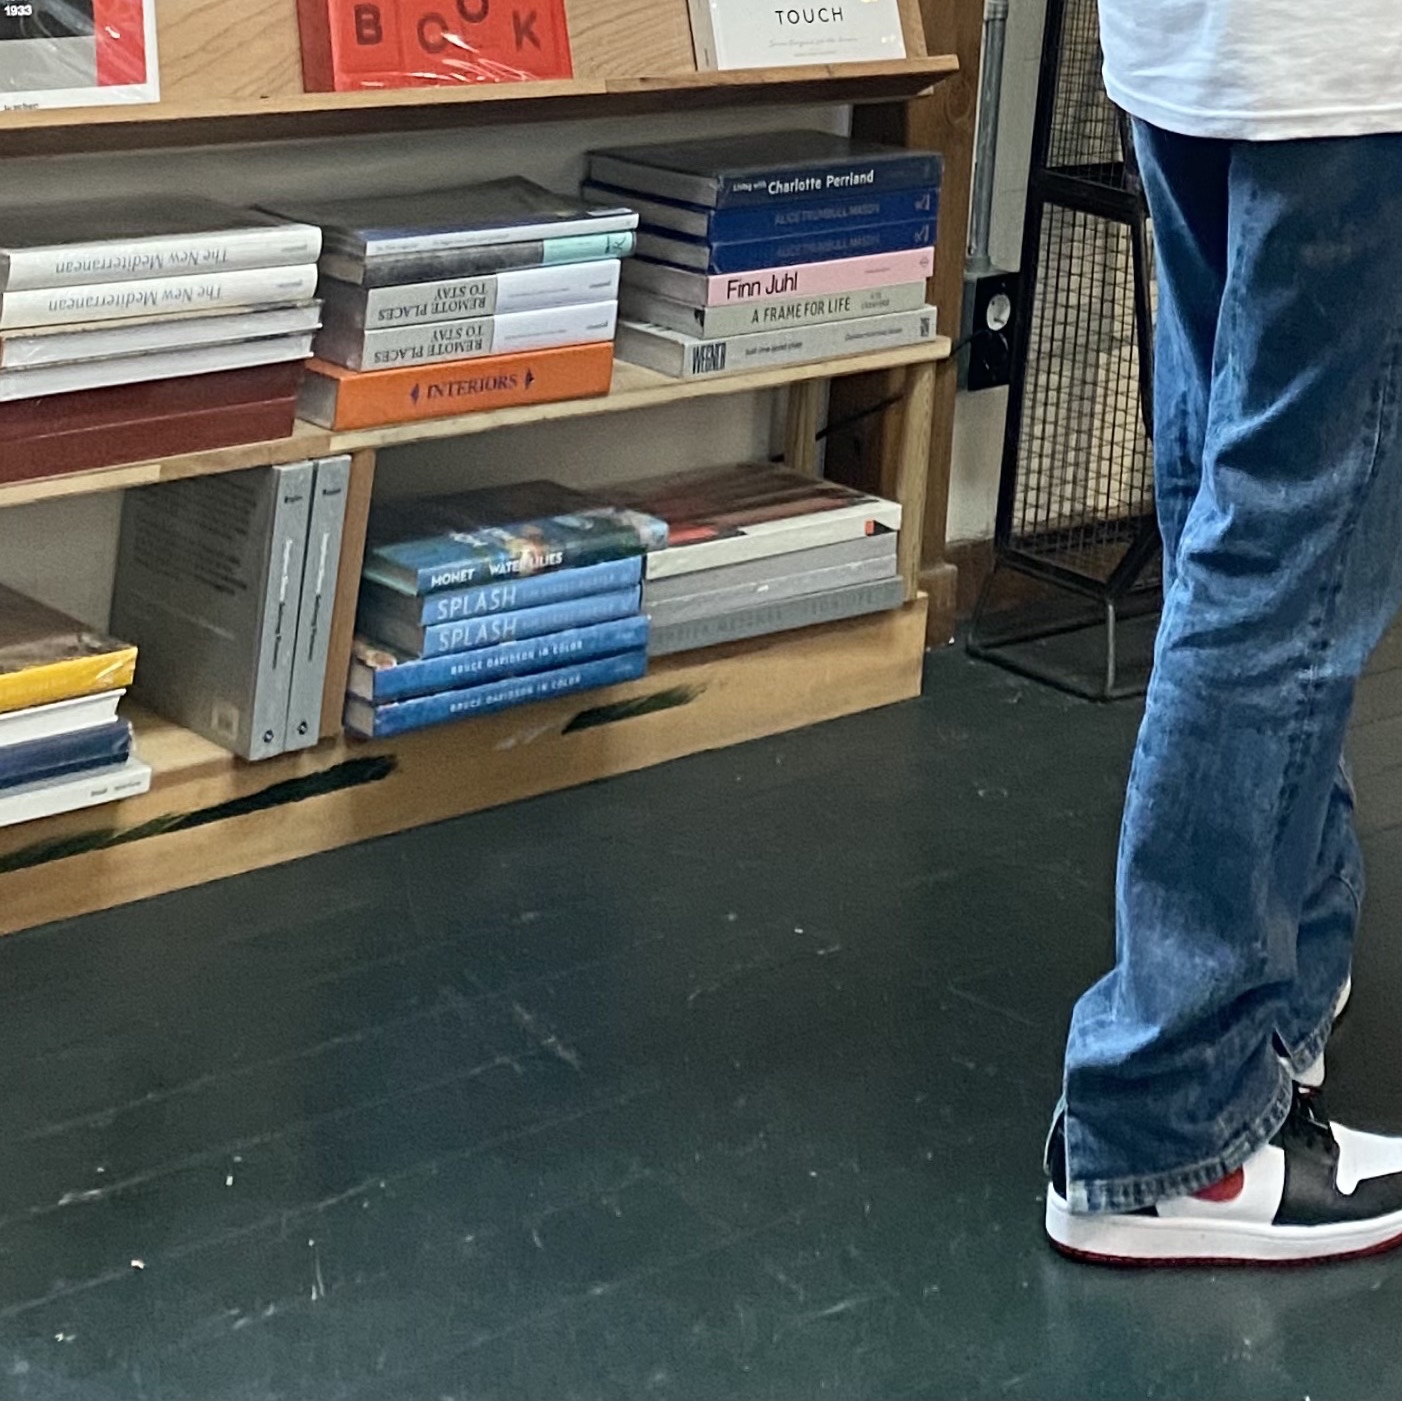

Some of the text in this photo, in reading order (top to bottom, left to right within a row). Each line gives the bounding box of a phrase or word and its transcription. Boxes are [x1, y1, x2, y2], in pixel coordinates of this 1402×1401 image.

[4, 4, 32, 17] 1933
[775, 7, 843, 25] TOUCH
[768, 177, 822, 195] Charlotte
[55, 249, 227, 275] The New Mediterranean
[49, 285, 222, 312] The New Mediterranean
[436, 282, 487, 300] TO STAY
[727, 272, 798, 300] Finn Juhl
[378, 297, 486, 322] REMOTE PLACES
[751, 309, 760, 324] A
[764, 302, 802, 322] FRAME
[804, 300, 825, 317] FOR
[828, 297, 850, 314] LIFE
[433, 325, 485, 342] TO STAY
[374, 339, 483, 364] REMOTE PLACES
[427, 375, 518, 400] INTERIORS
[431, 568, 476, 588] MONET
[437, 586, 517, 620] SPLASH
[438, 617, 518, 652] SPLASH
[451, 661, 482, 675] BRUCE
[487, 651, 535, 668] DAVIDSON
[552, 640, 583, 654] COLOR
[450, 699, 482, 712] BRUCE
[486, 686, 534, 705] DAVIDSON
[552, 675, 581, 690] COLOR
